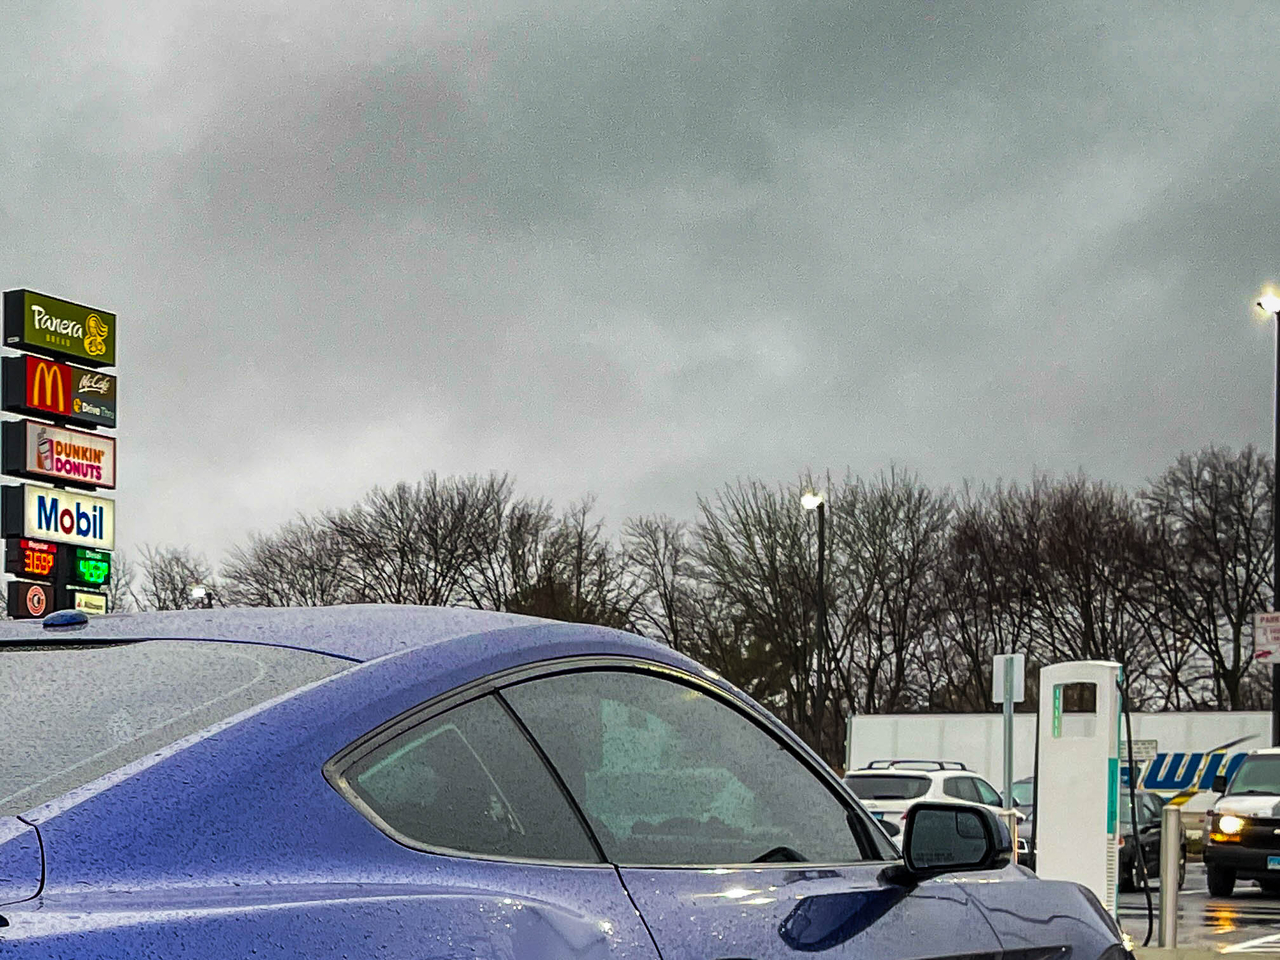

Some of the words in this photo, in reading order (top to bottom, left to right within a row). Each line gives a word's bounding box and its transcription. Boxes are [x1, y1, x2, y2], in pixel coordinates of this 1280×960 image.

[31, 305, 83, 338] Panera
[55, 441, 105, 464] DUNKIN'
[55, 457, 102, 481] DONUTS
[37, 495, 104, 540] Mobil
